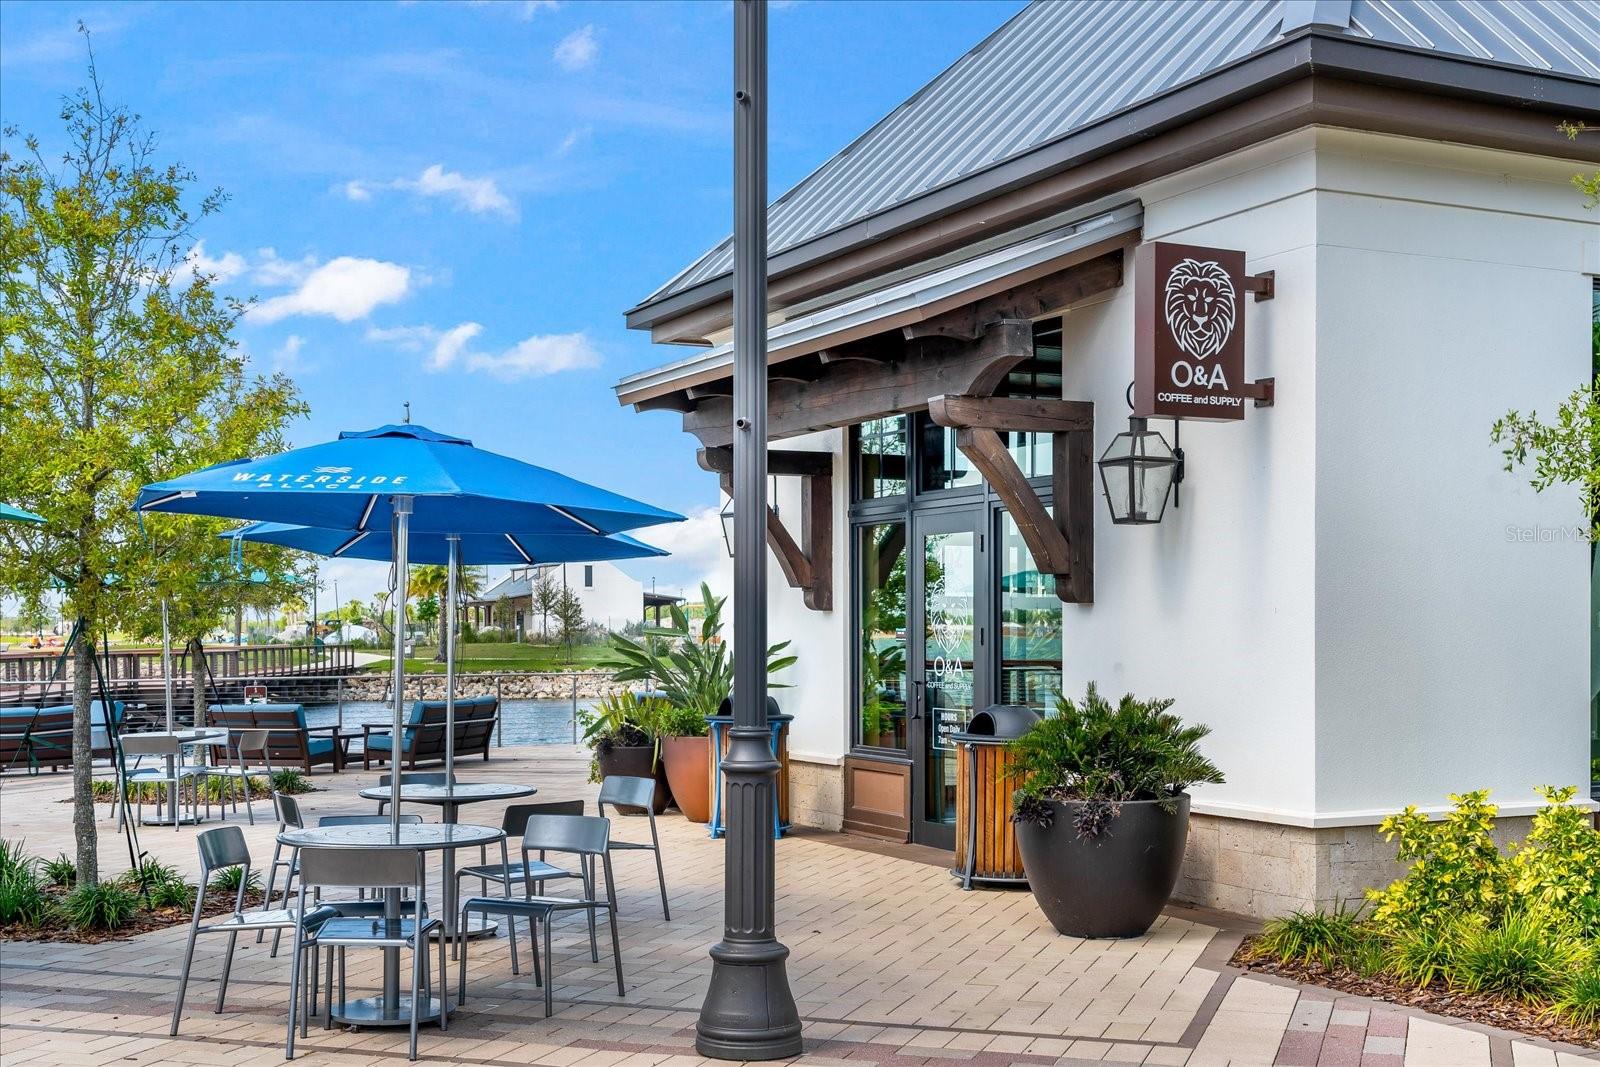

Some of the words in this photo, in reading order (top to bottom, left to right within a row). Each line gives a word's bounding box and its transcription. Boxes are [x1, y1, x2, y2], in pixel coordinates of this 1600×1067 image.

[1171, 360, 1229, 391] O&A
[1157, 392, 1193, 404] COFFEE
[1193, 396, 1209, 405] and
[1209, 395, 1242, 407] SUPPLY
[233, 472, 408, 485] WATERSIDE
[934, 655, 964, 678] O&A
[926, 681, 945, 689] COFFEE
